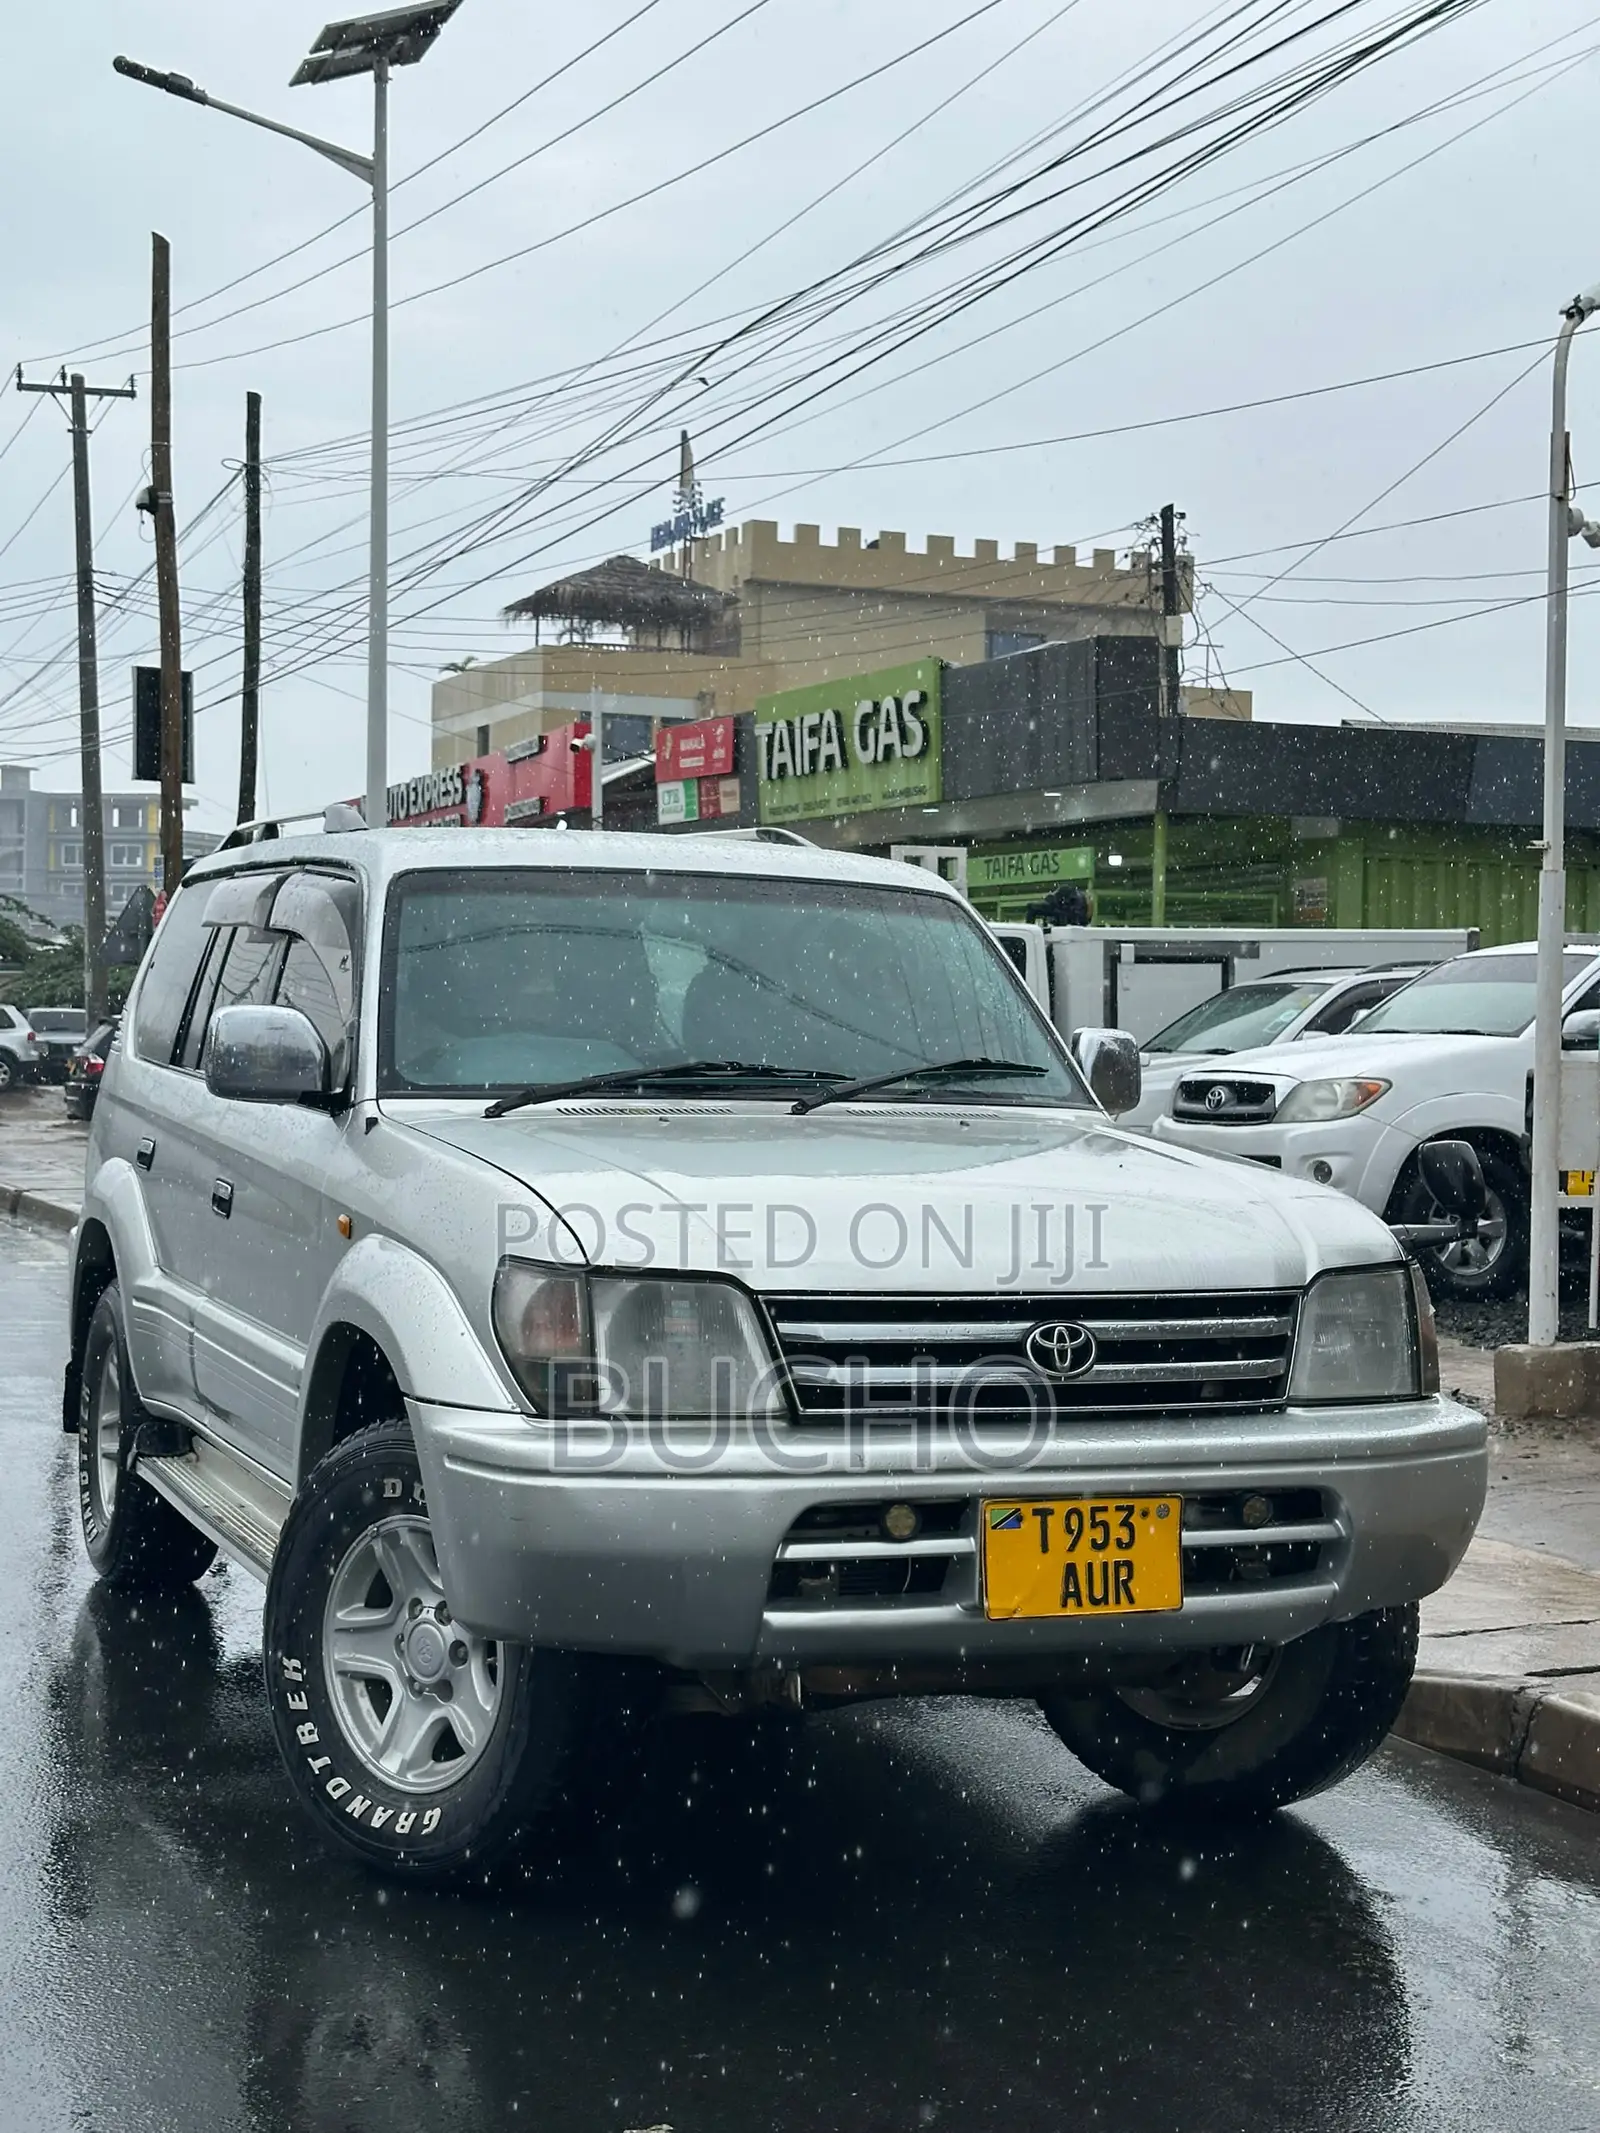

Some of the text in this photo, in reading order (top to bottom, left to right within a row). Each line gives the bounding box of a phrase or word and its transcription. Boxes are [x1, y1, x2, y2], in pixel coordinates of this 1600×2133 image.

[754, 690, 924, 780] TAIFA GAS
[408, 766, 463, 816] EXPRESS
[984, 852, 1060, 880] TAIFA GAS
[1032, 1504, 1136, 1553] T 953
[1060, 1558, 1136, 1608] AUR
